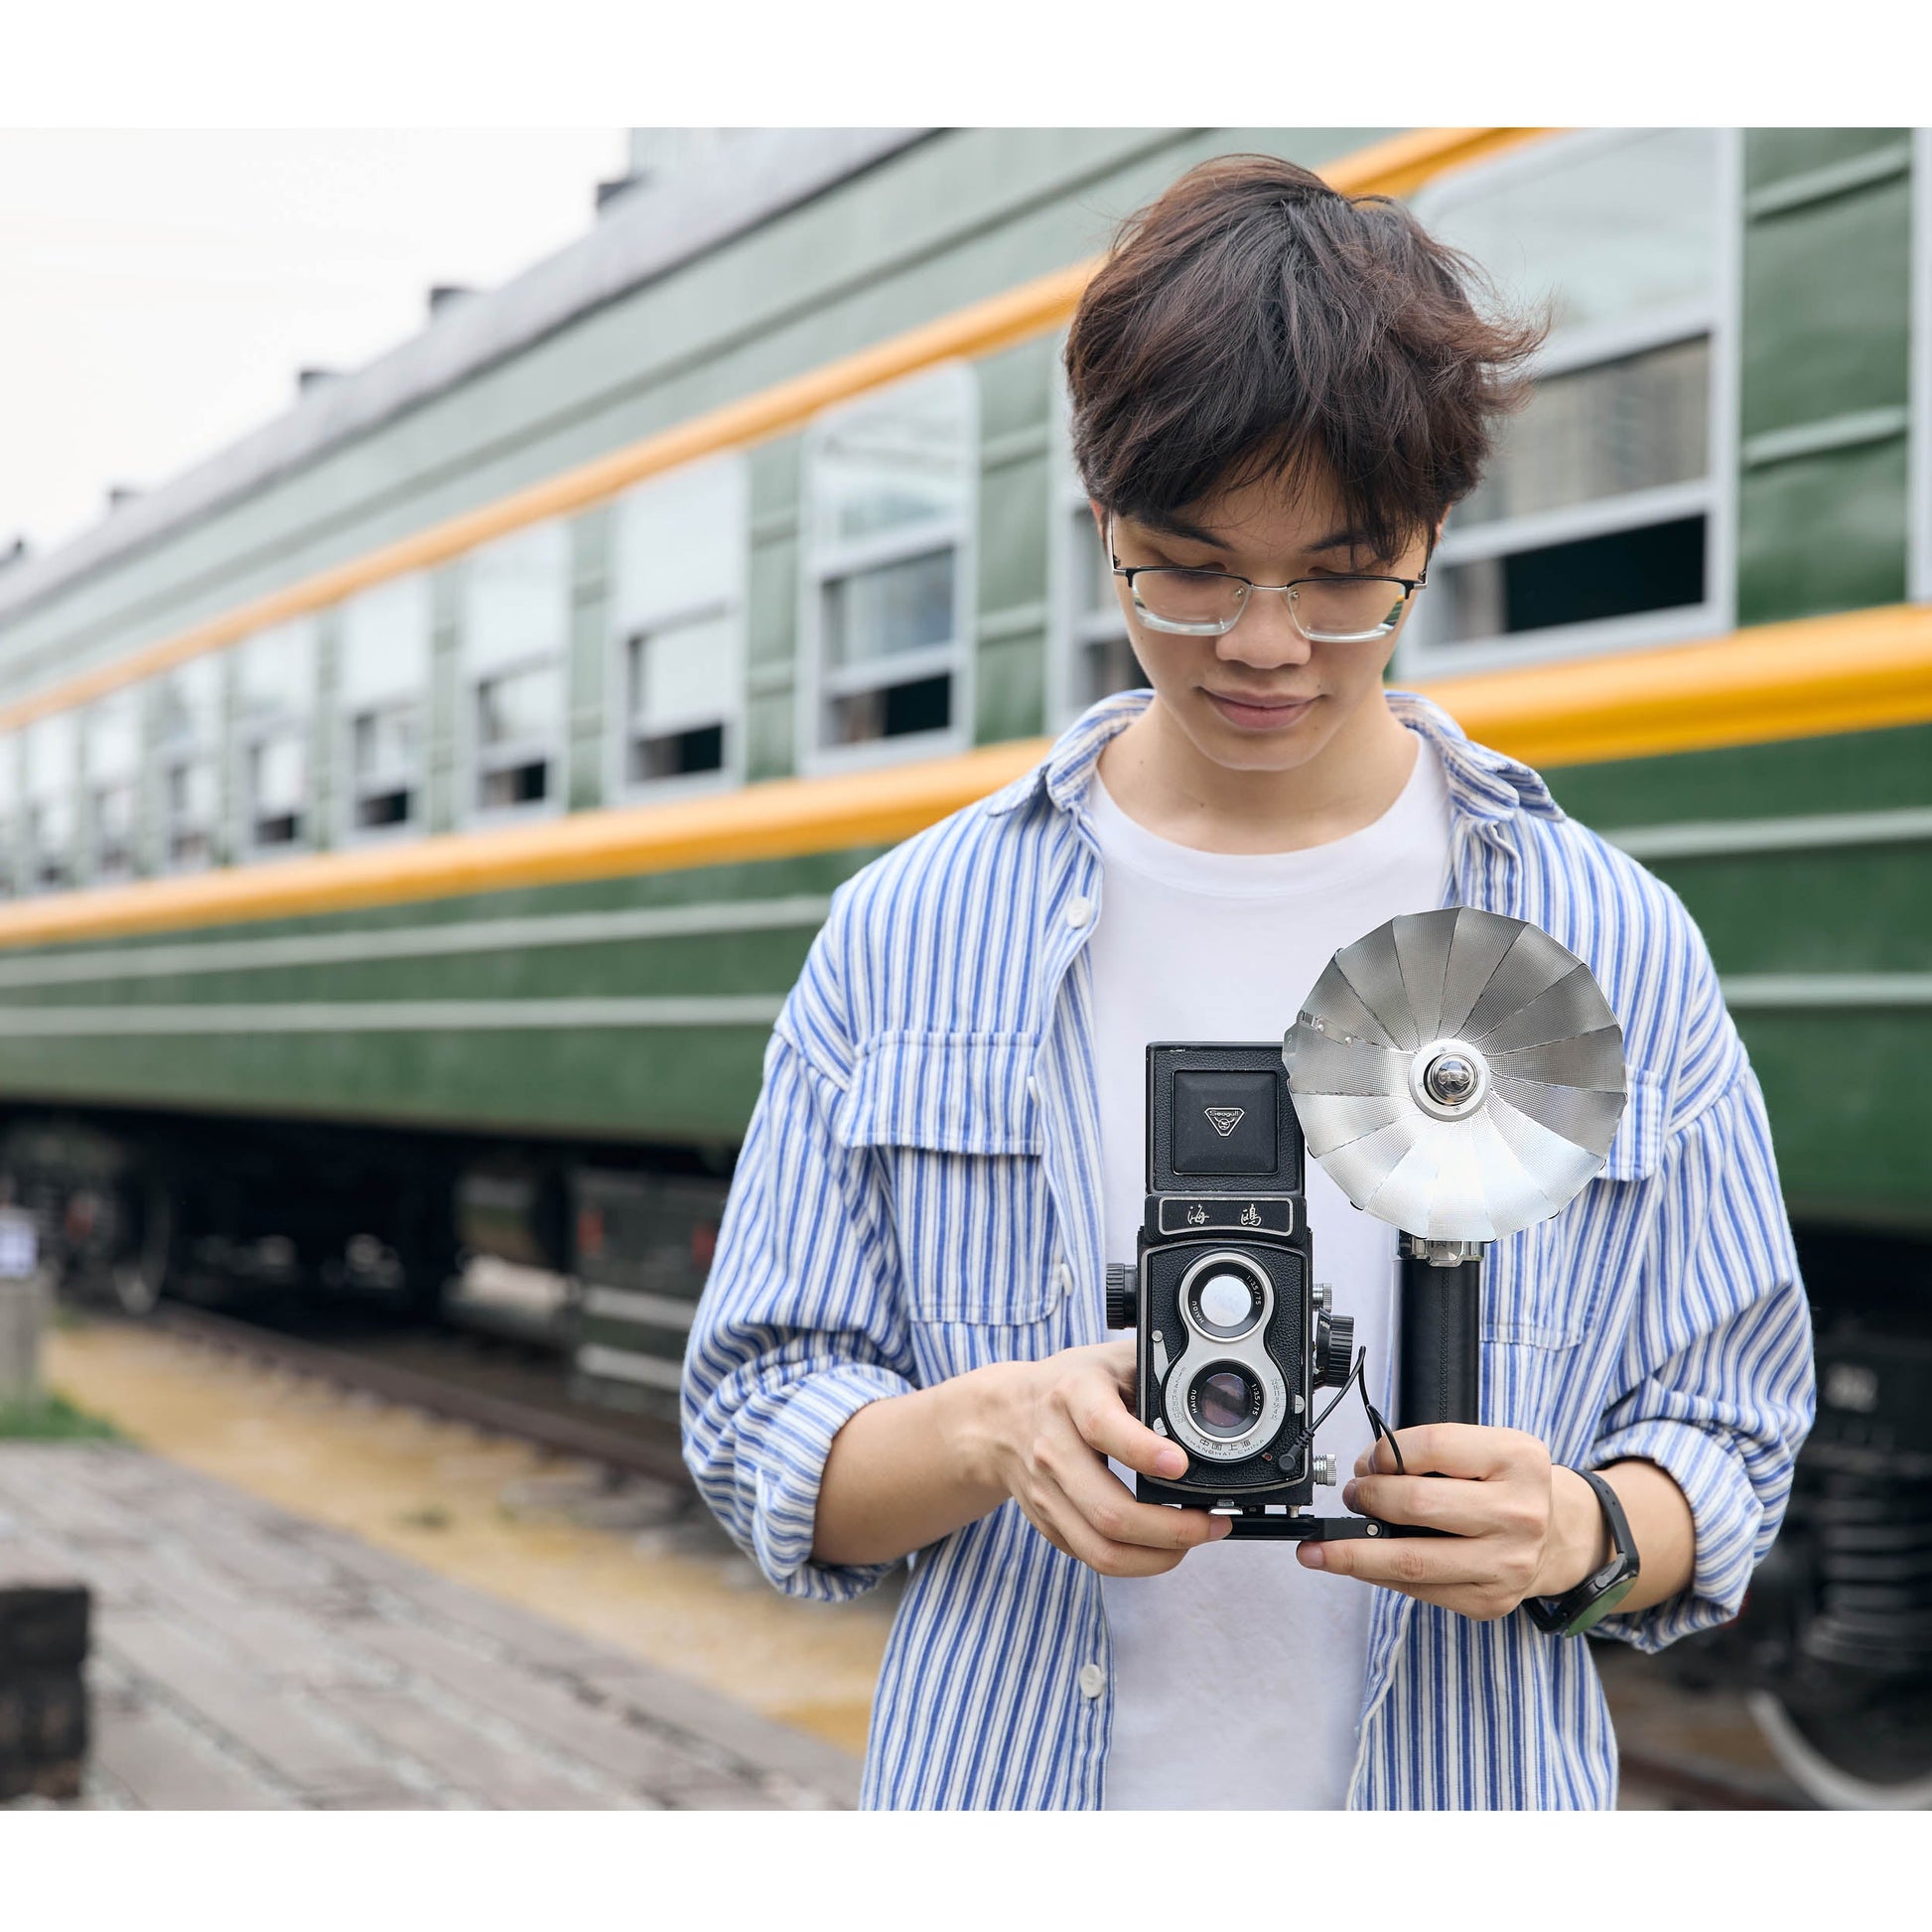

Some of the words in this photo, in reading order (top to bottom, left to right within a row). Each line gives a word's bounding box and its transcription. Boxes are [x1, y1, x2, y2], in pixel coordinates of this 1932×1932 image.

[1191, 1301, 1205, 1324] HAIOU
[1190, 1389, 1199, 1415] HAIOU
[1199, 1439, 1222, 1450] 中国
[1228, 1440, 1251, 1451] 上海
